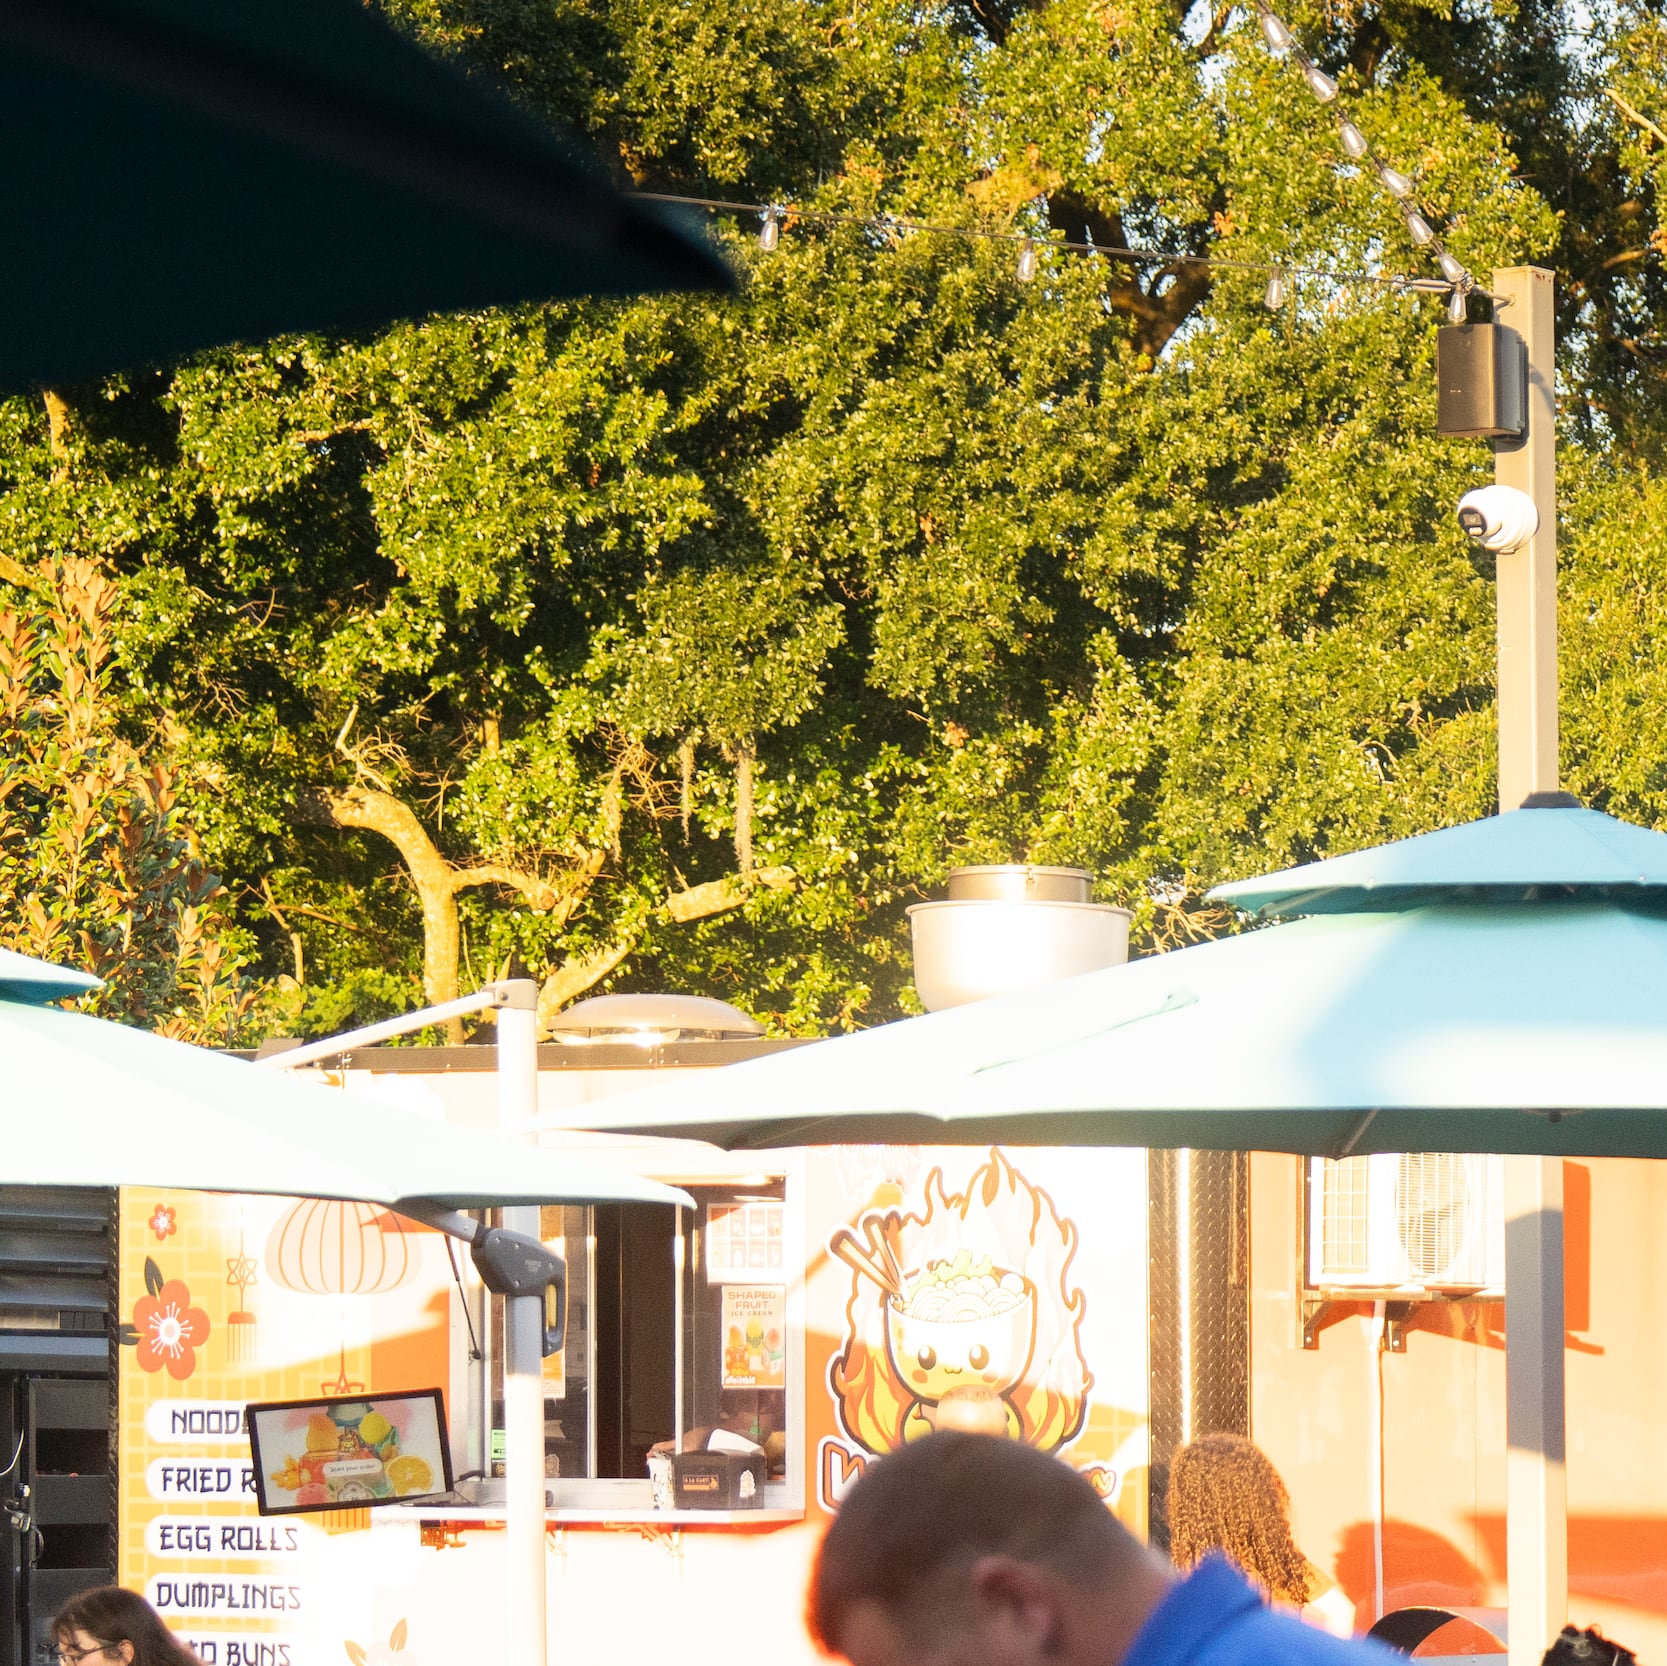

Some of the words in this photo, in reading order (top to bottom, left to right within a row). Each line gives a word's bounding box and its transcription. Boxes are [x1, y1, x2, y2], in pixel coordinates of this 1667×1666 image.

[728, 1291, 777, 1300] SHAPED
[735, 1301, 769, 1310] FRUIT
[171, 1409, 250, 1434] NOOD
[161, 1466, 231, 1493] FRIED
[159, 1524, 213, 1552] EGG
[221, 1525, 297, 1552] ROLLS
[156, 1582, 302, 1611] DUMPLINGS
